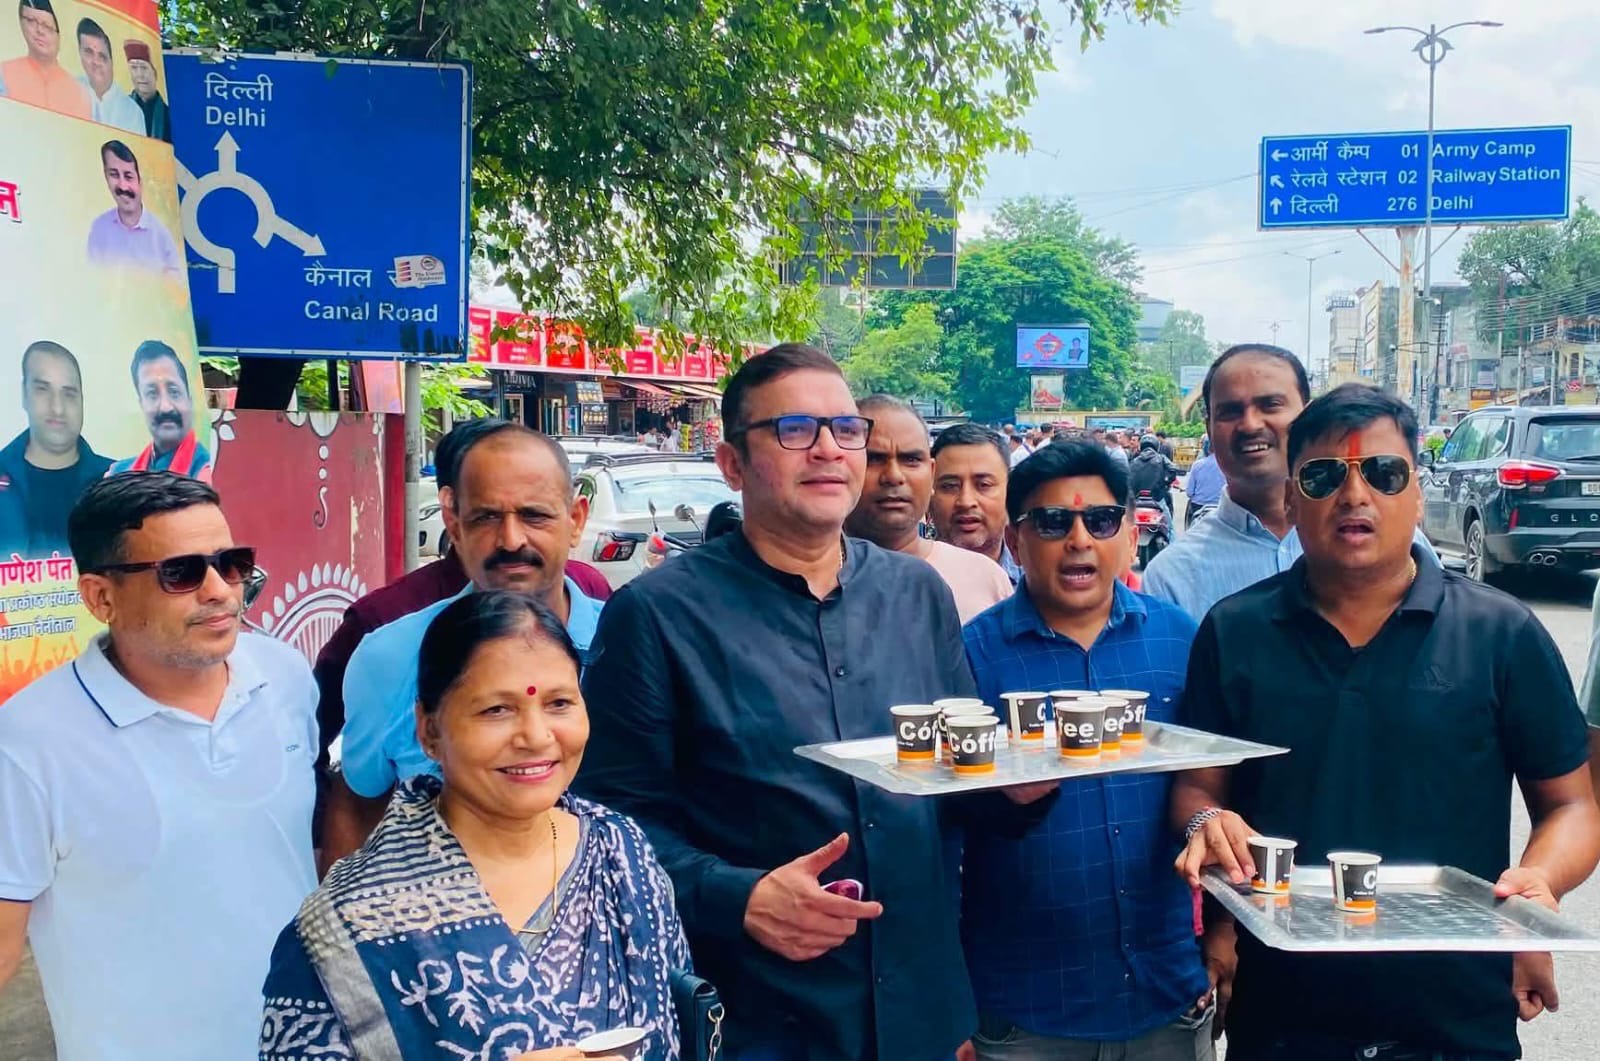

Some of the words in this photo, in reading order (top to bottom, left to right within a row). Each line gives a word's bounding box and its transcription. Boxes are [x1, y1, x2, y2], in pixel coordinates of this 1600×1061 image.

[204, 72, 273, 101] दिल्ली
[206, 106, 266, 127] Delhi
[1290, 141, 1328, 161] आर्मी
[1336, 141, 1370, 160] कैम्प
[1401, 143, 1419, 158] 01
[1432, 143, 1479, 159] Army
[1484, 140, 1536, 158] Camp
[1290, 168, 1328, 188] रेलवे
[1336, 167, 1387, 186] स्टेशन
[1398, 170, 1418, 184] 02
[1431, 168, 1496, 185] Railway
[1499, 166, 1561, 181] Station
[1289, 193, 1339, 215] दिल्ली
[1387, 196, 1418, 213] 276
[1430, 195, 1474, 210] Delhi
[303, 260, 373, 288] कैनाल
[304, 301, 370, 321] Canal
[379, 303, 439, 323] Road
[46, 552, 73, 581] पंत
